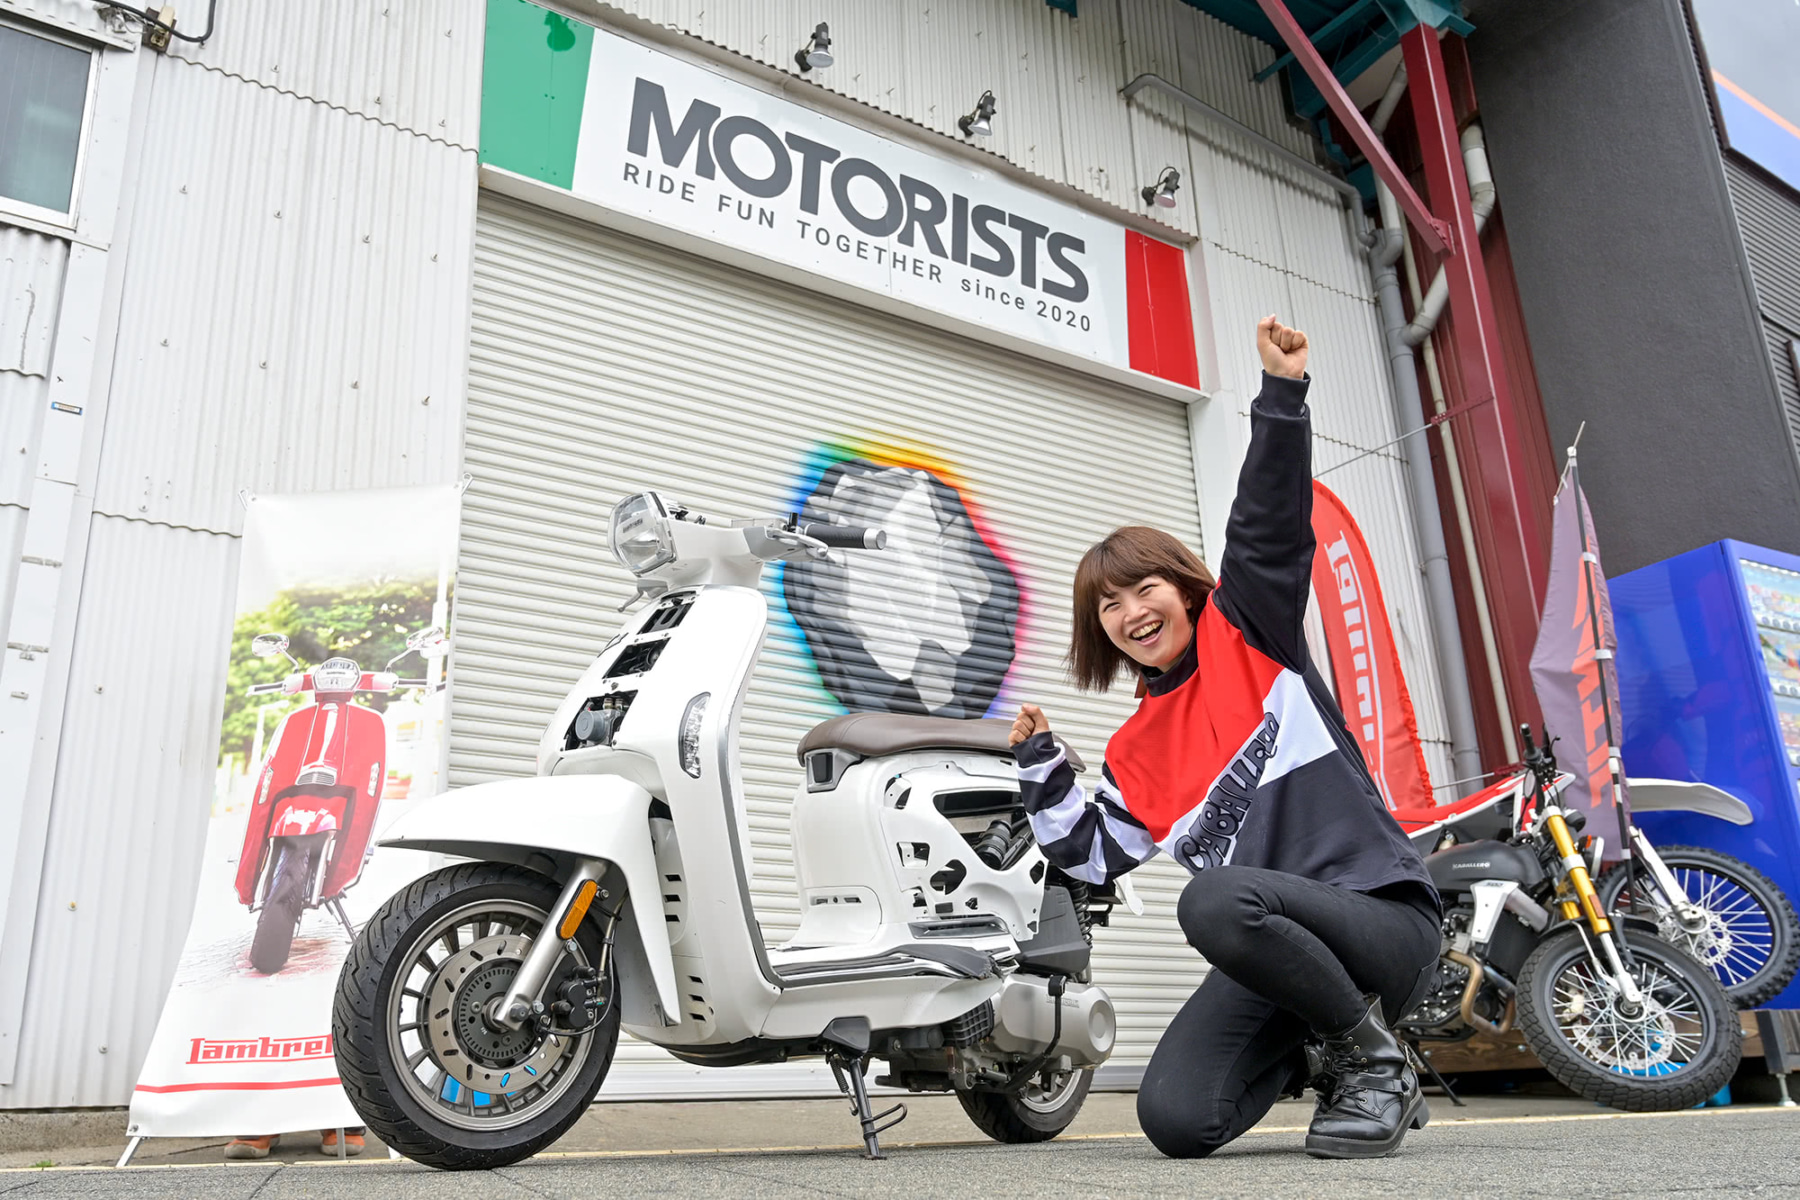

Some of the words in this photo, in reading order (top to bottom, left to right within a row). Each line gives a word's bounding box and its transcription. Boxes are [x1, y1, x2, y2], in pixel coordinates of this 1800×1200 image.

[623, 162, 696, 203] RIDE
[718, 193, 775, 229] FUN
[796, 219, 942, 283] TOGETHER
[960, 278, 1025, 310] since
[1036, 300, 1091, 332] 2020
[626, 76, 1090, 304] MOTORISTS
